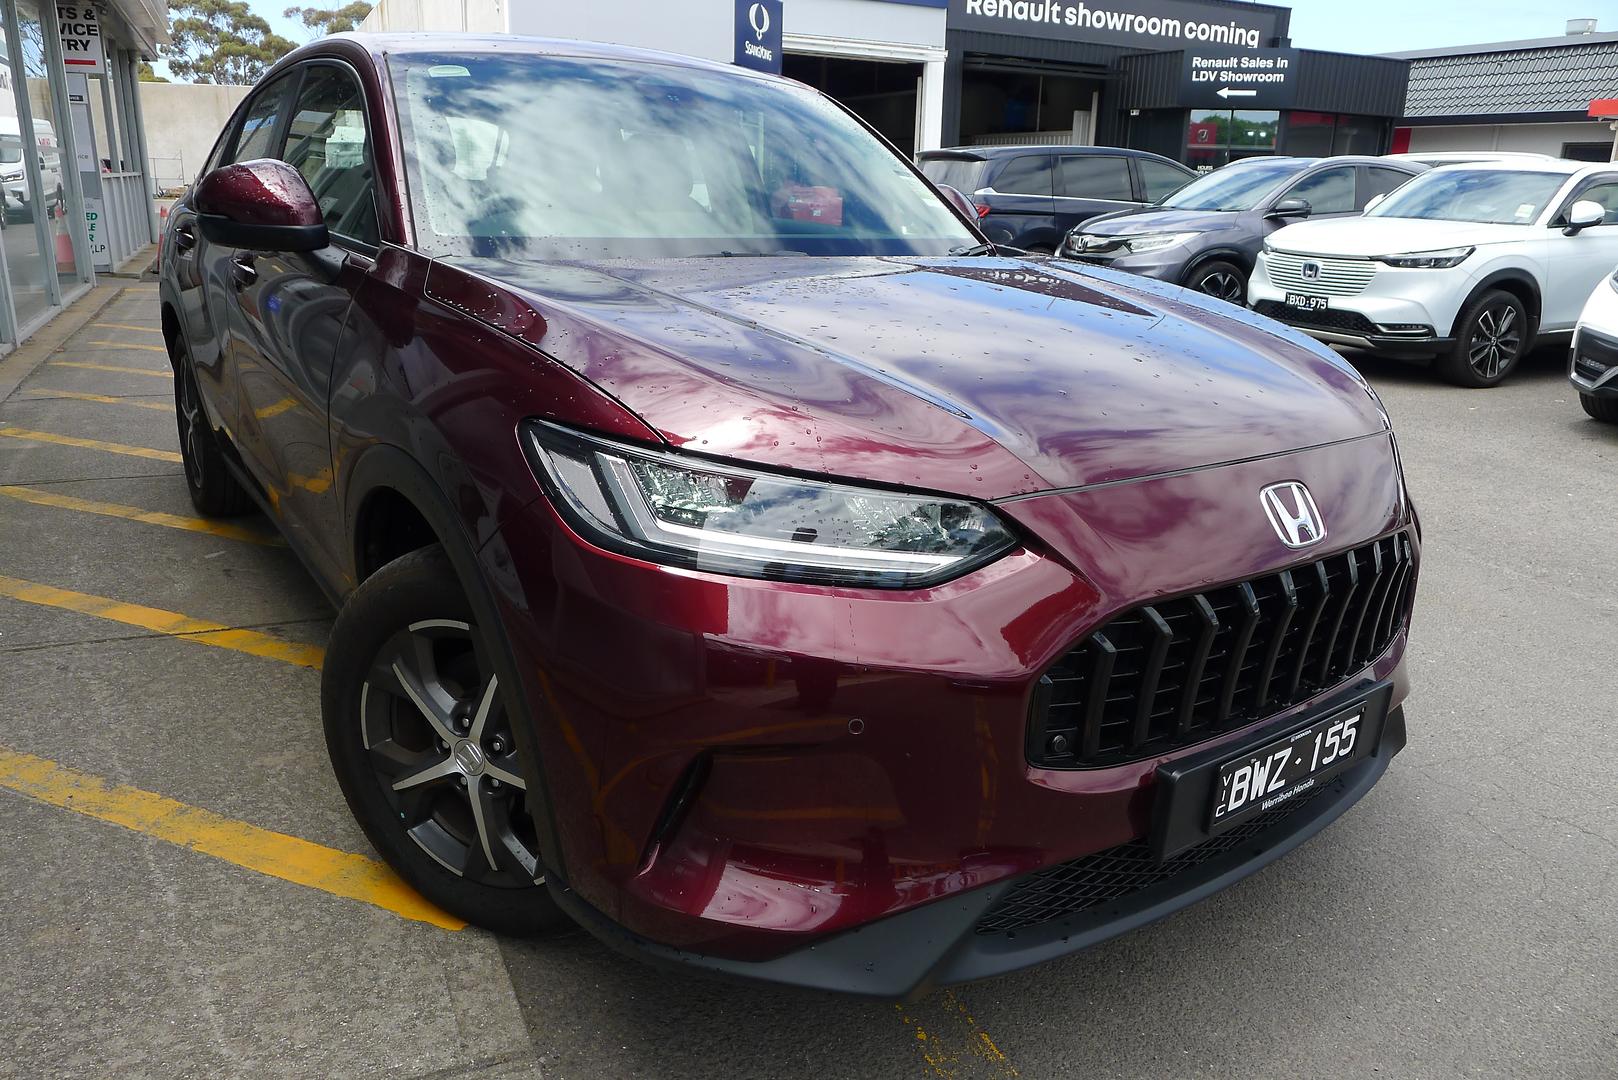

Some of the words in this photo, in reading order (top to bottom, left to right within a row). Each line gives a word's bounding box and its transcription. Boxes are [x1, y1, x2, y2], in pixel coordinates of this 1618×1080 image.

[84, 9, 96, 20] &
[966, 0, 1061, 24] Renault
[1065, 2, 1181, 38] showroom
[1184, 21, 1260, 49] coming
[1192, 57, 1238, 68] Renault
[1240, 57, 1274, 68] Sales
[1277, 57, 1288, 68] in
[1192, 71, 1218, 81] LDV
[1219, 71, 1285, 82] Showroom
[1310, 715, 1361, 772] 155
[1293, 778, 1315, 795] Honda
